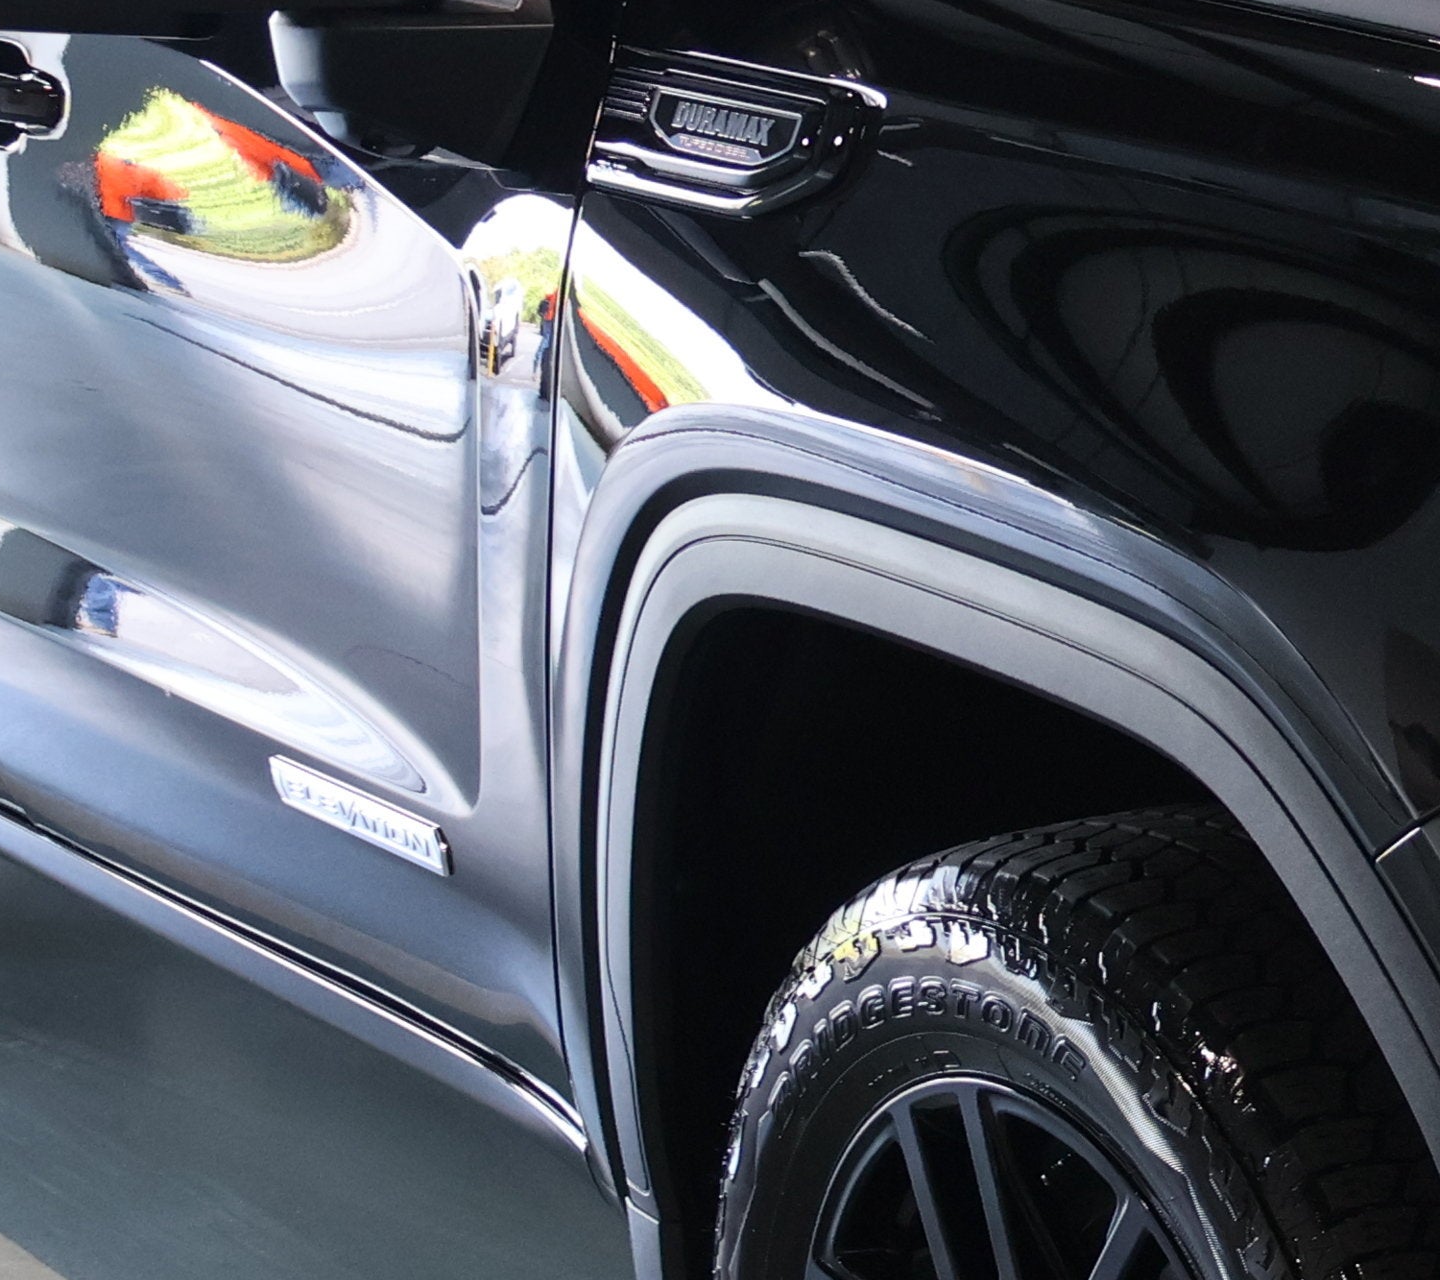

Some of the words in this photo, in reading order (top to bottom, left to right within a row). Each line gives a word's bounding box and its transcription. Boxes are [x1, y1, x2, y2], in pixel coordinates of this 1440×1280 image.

[671, 101, 775, 146] DURAMAX
[287, 780, 432, 858] ELEVATION
[767, 975, 1089, 1112] BRIDGESTONE
